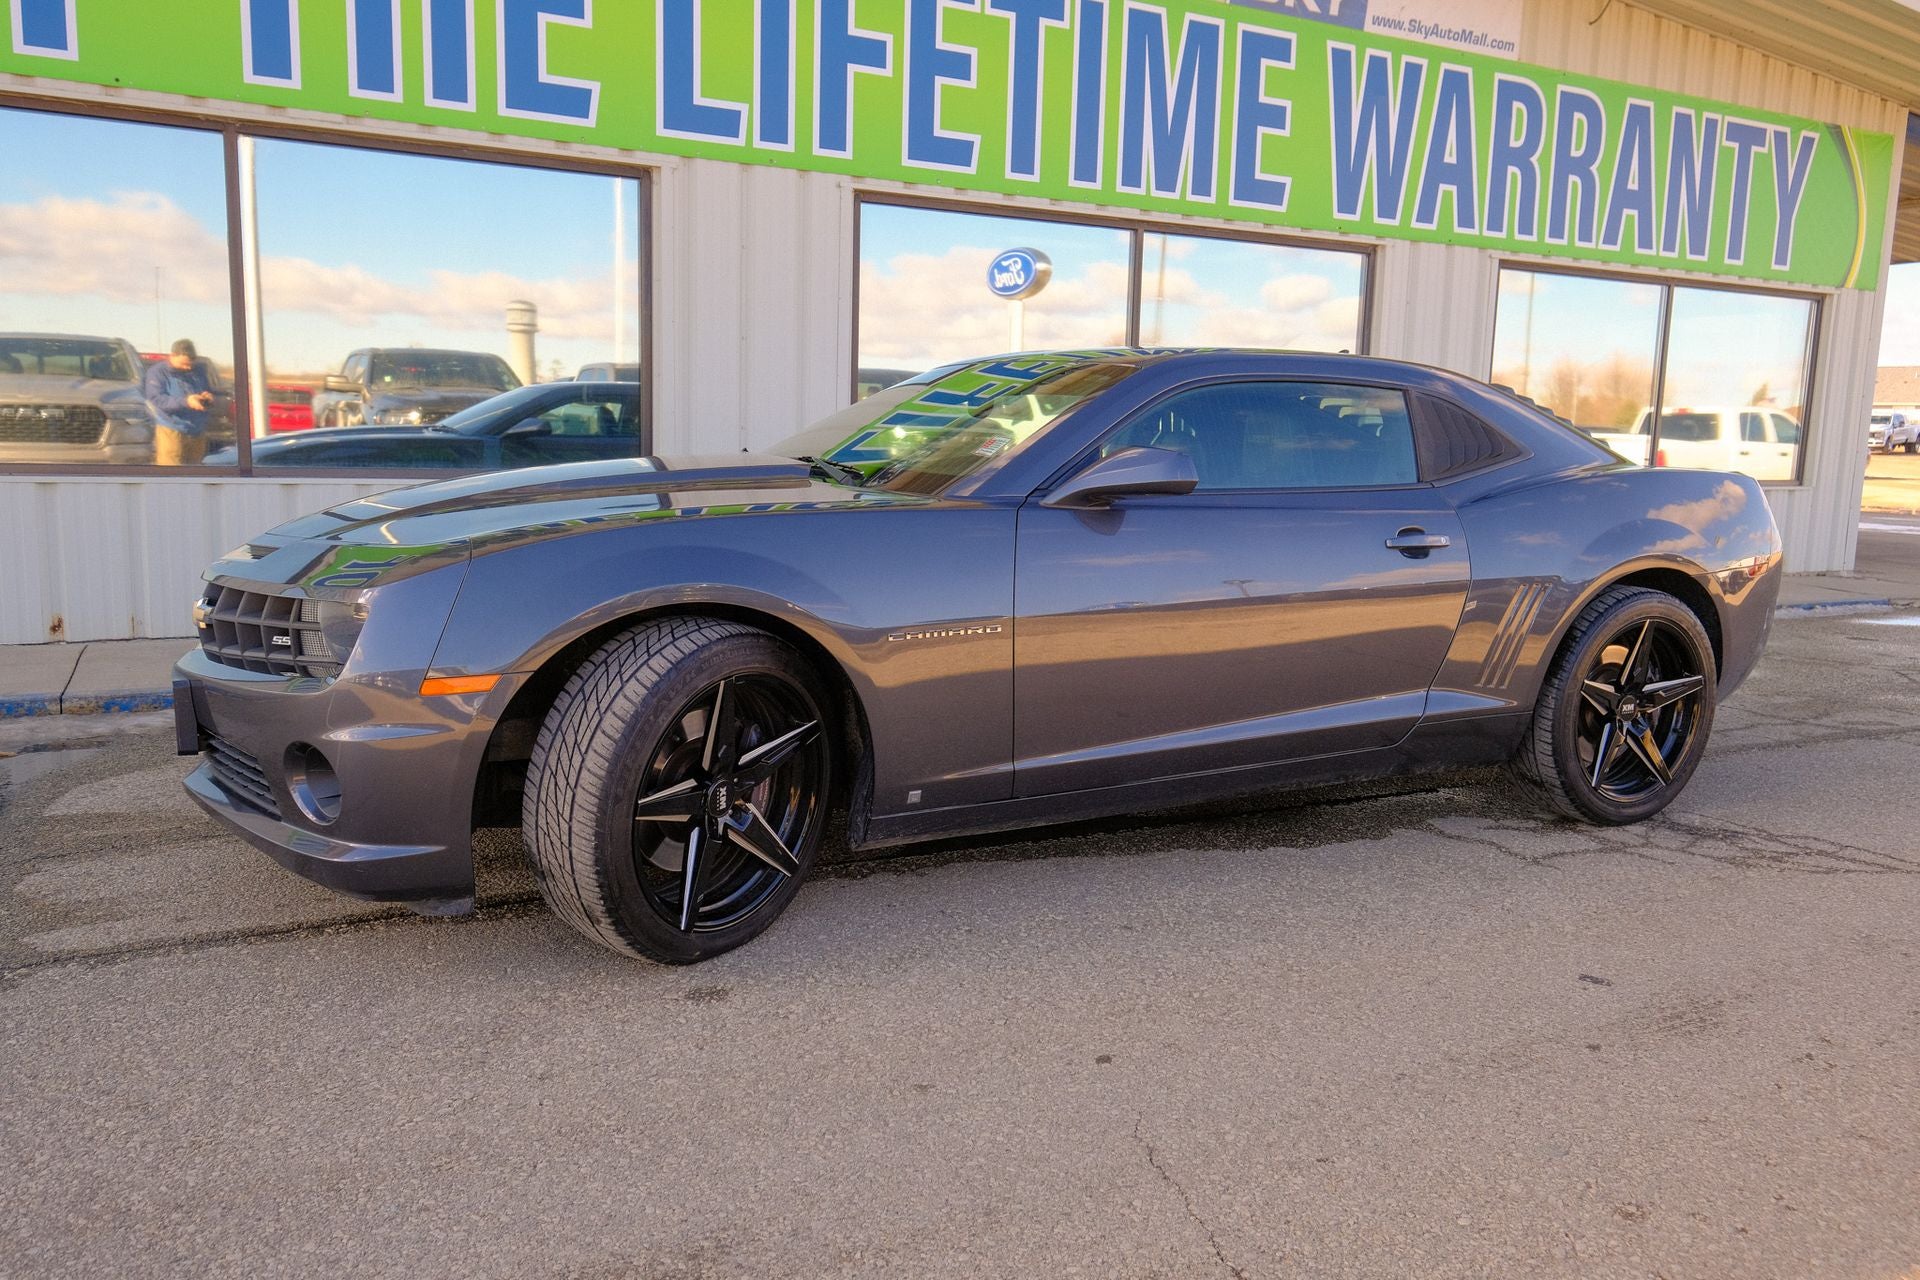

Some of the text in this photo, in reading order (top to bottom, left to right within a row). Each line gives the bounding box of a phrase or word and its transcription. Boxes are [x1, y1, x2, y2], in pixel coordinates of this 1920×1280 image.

[1372, 14, 1515, 53] www.SkyAutoMall.com
[656, 0, 1297, 213] LIFETIME
[1326, 39, 1821, 271] WARRANTY
[271, 635, 292, 646] SS
[888, 624, 1002, 641] CAMARO
